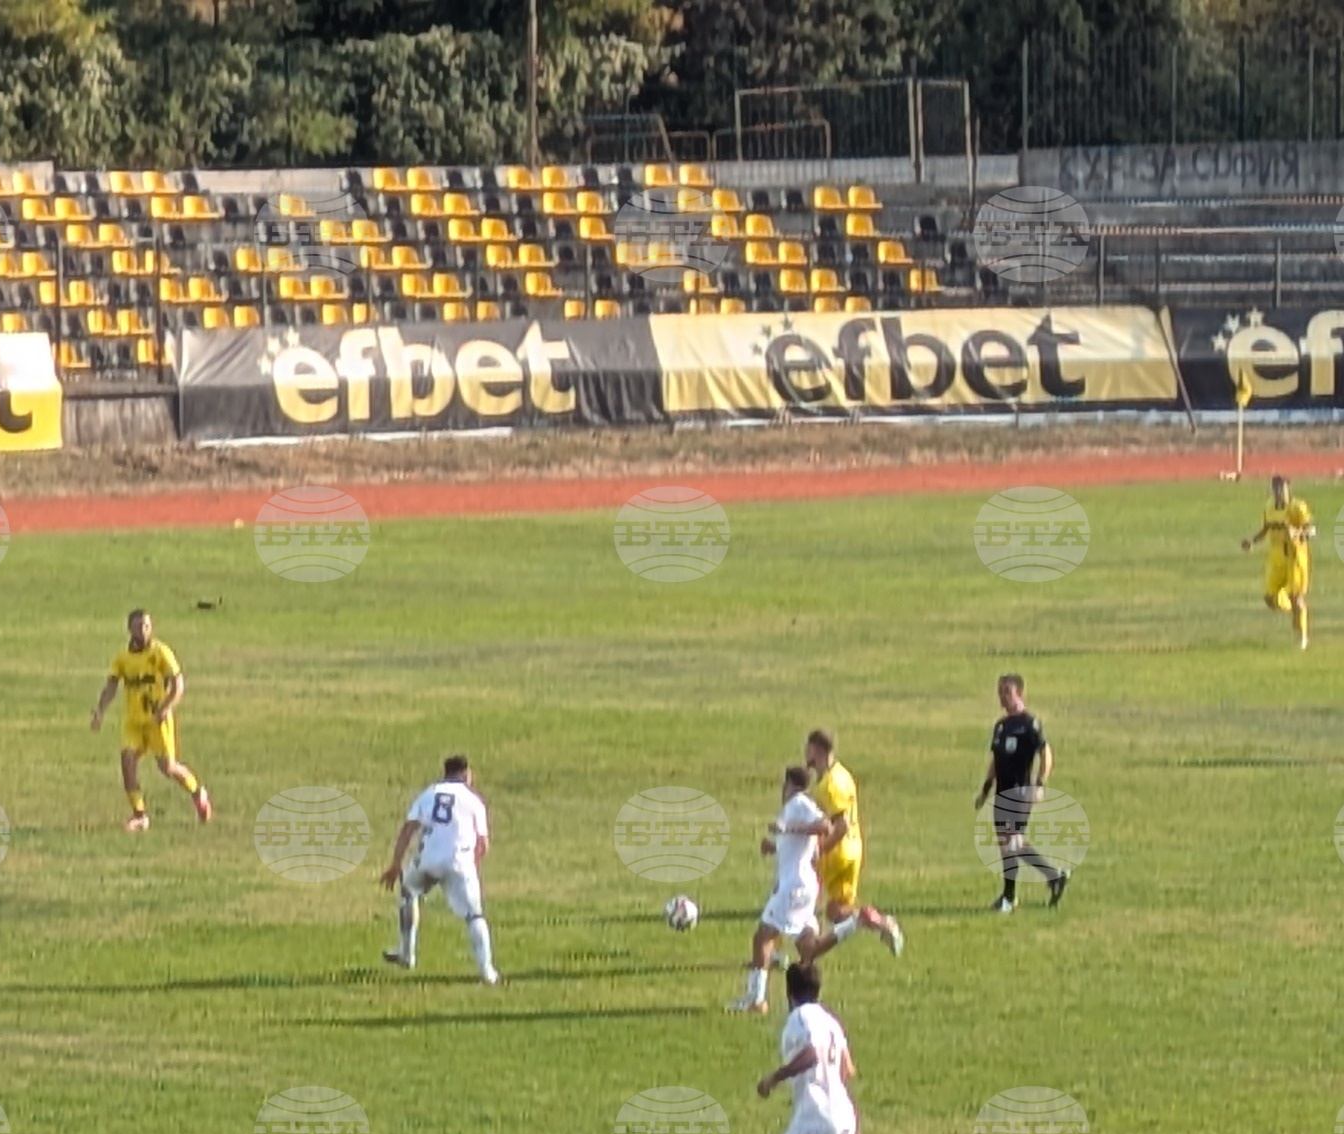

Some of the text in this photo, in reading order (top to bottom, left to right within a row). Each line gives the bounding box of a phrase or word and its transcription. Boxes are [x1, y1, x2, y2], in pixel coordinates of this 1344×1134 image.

[273, 320, 576, 423] efbet
[765, 313, 1086, 403] efbet
[432, 792, 455, 824] 8
